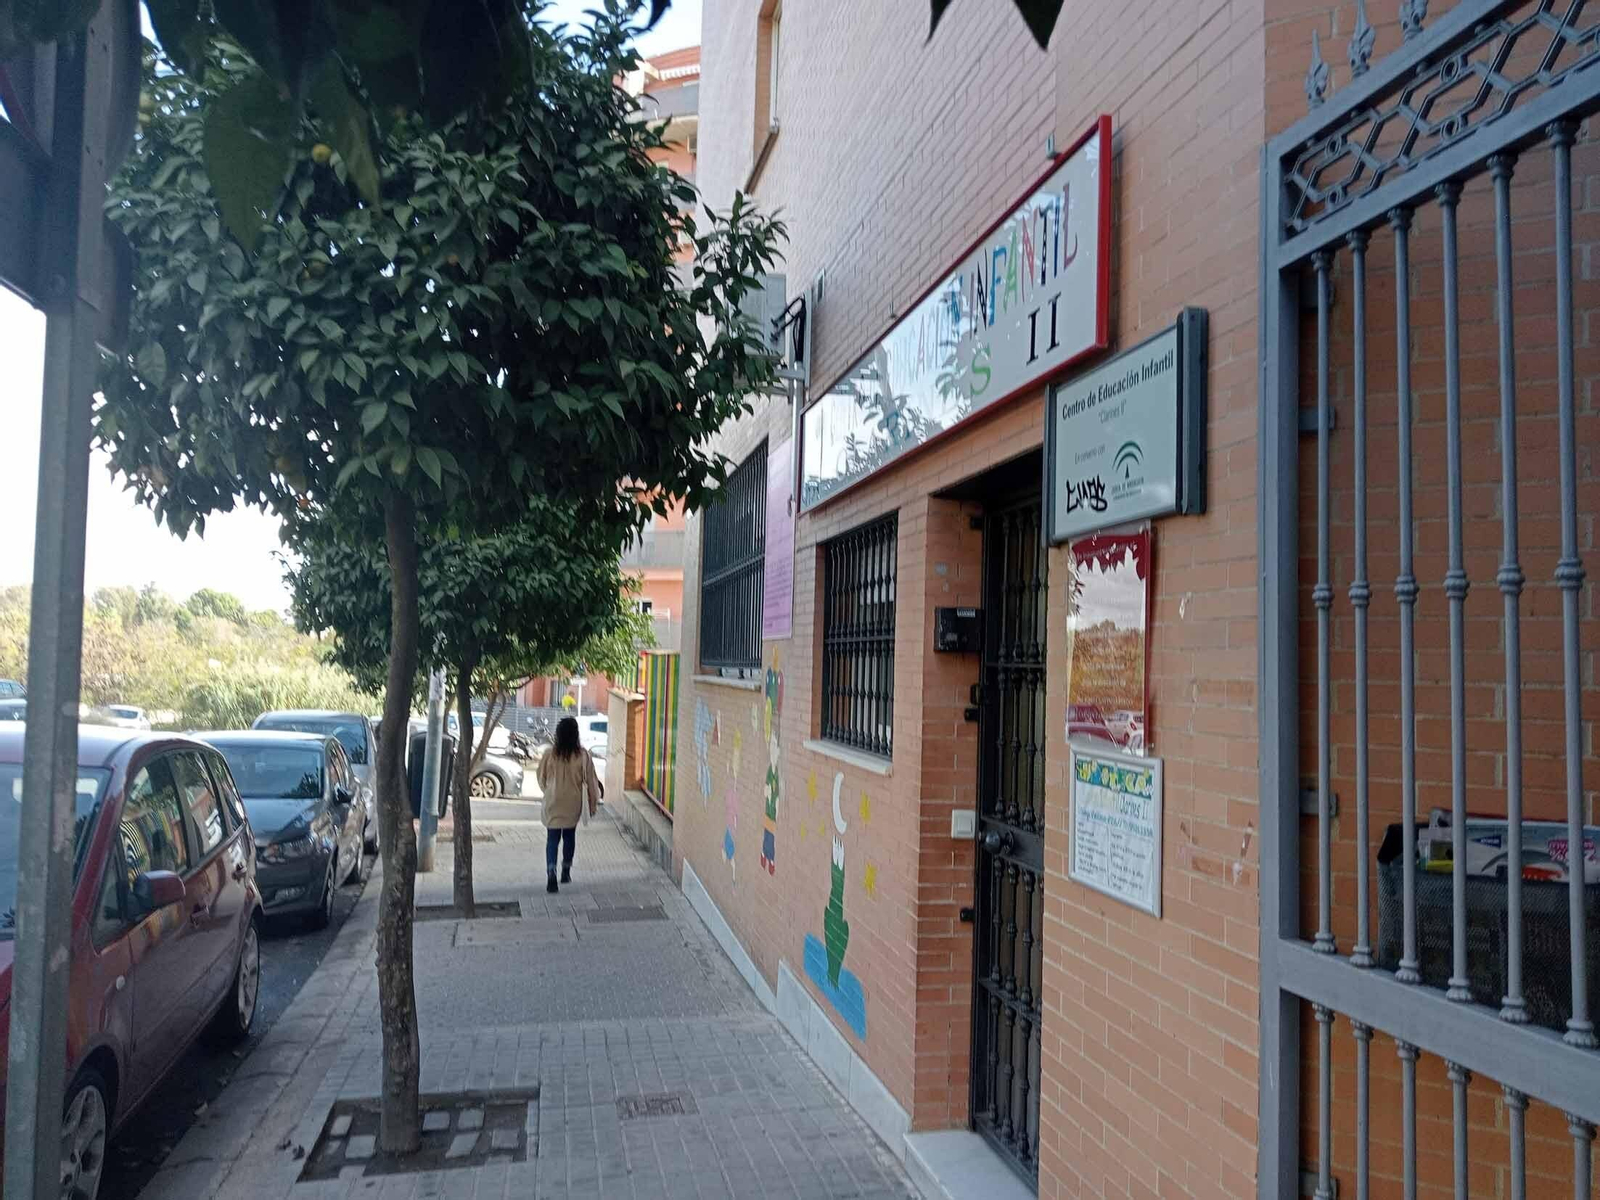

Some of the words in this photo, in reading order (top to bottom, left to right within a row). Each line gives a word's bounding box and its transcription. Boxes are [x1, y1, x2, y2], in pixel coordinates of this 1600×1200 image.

[968, 181, 1078, 341] INFANTIL
[1062, 398, 1086, 421] Centro
[1087, 391, 1097, 408] de
[1098, 370, 1139, 404] Educación
[1141, 348, 1174, 382] Infantil
